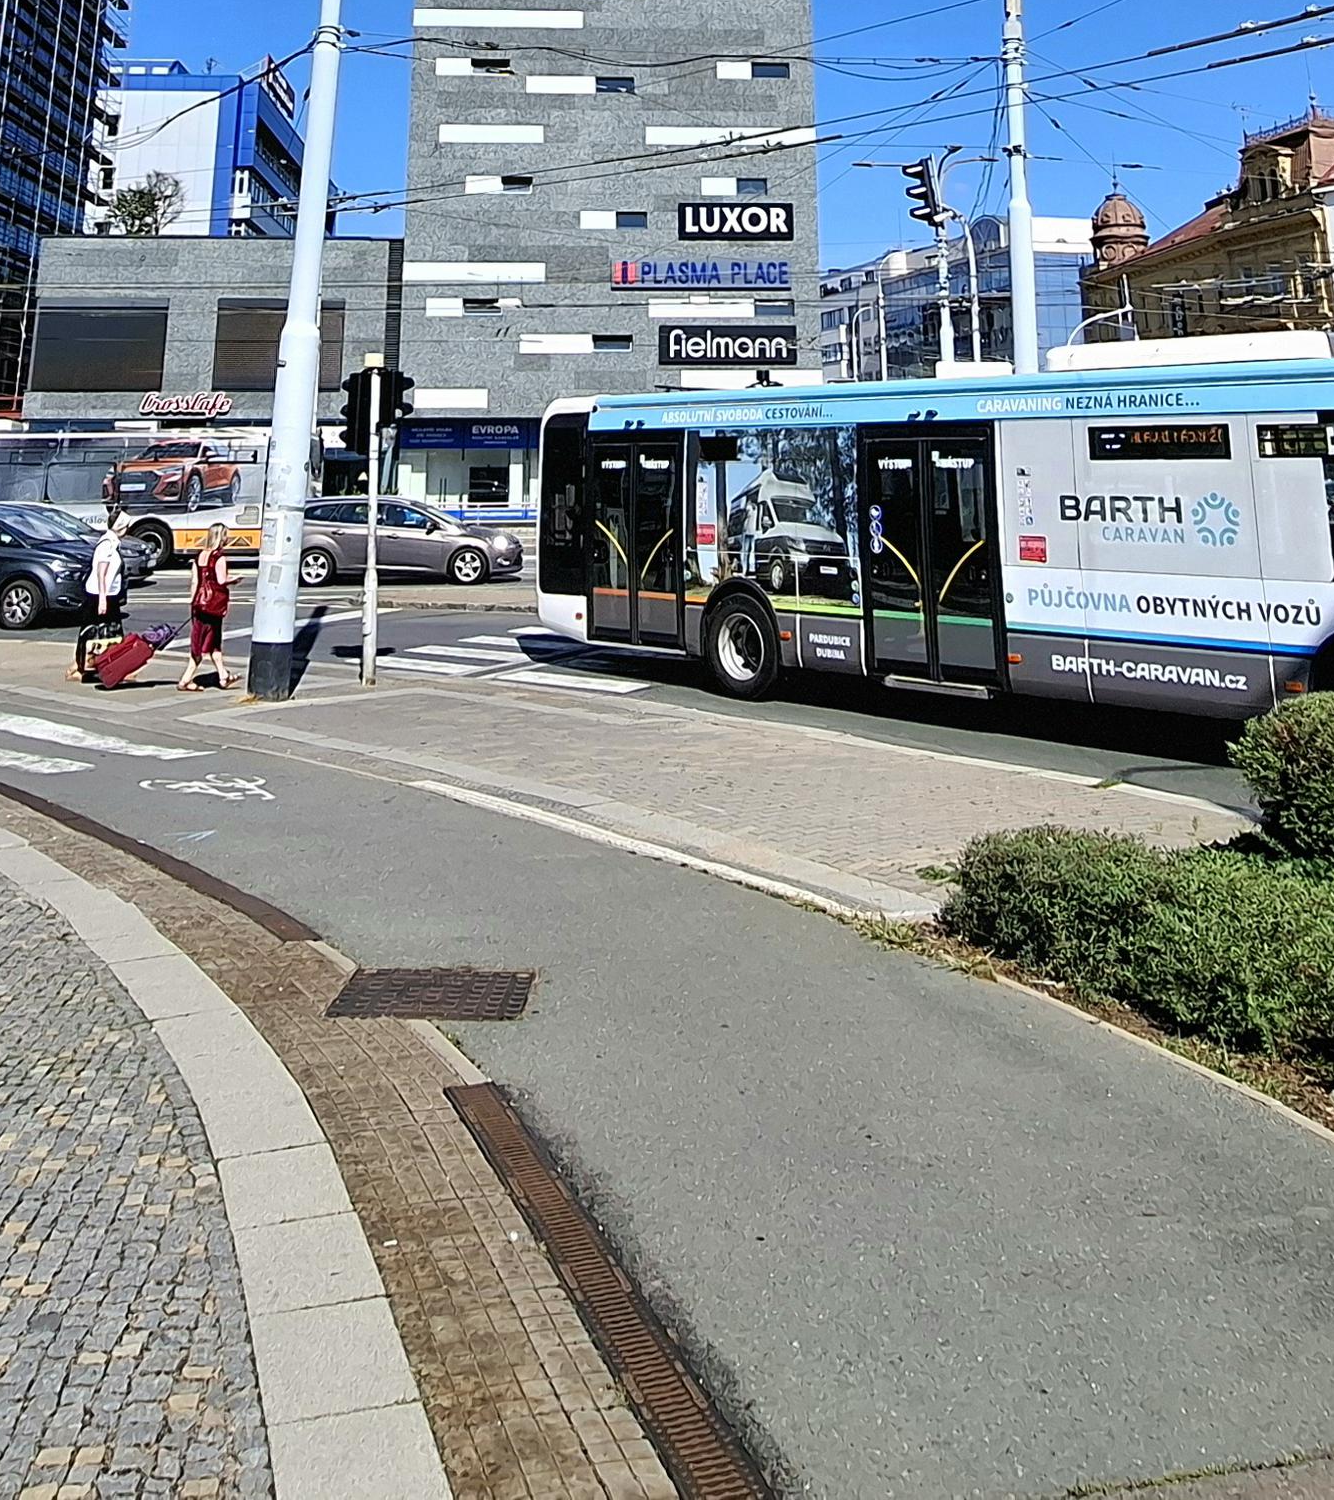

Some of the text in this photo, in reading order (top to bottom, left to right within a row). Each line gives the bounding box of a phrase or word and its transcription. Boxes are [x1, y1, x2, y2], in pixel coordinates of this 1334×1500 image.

[685, 206, 789, 233] LUXOR
[641, 261, 789, 284] PLASMA PLACE
[976, 397, 1062, 413] CARAVANING
[1065, 393, 1113, 410] NEZNÁ
[661, 408, 714, 423] ABSOLUTNÍ
[716, 408, 763, 421] SVOBODA
[471, 425, 519, 435] EVROPA
[1059, 494, 1183, 523] BARTH
[1102, 526, 1185, 544] CARAVAN
[1027, 583, 1321, 626] PŮJČOVNA OBYTNÝCH VOZŮ
